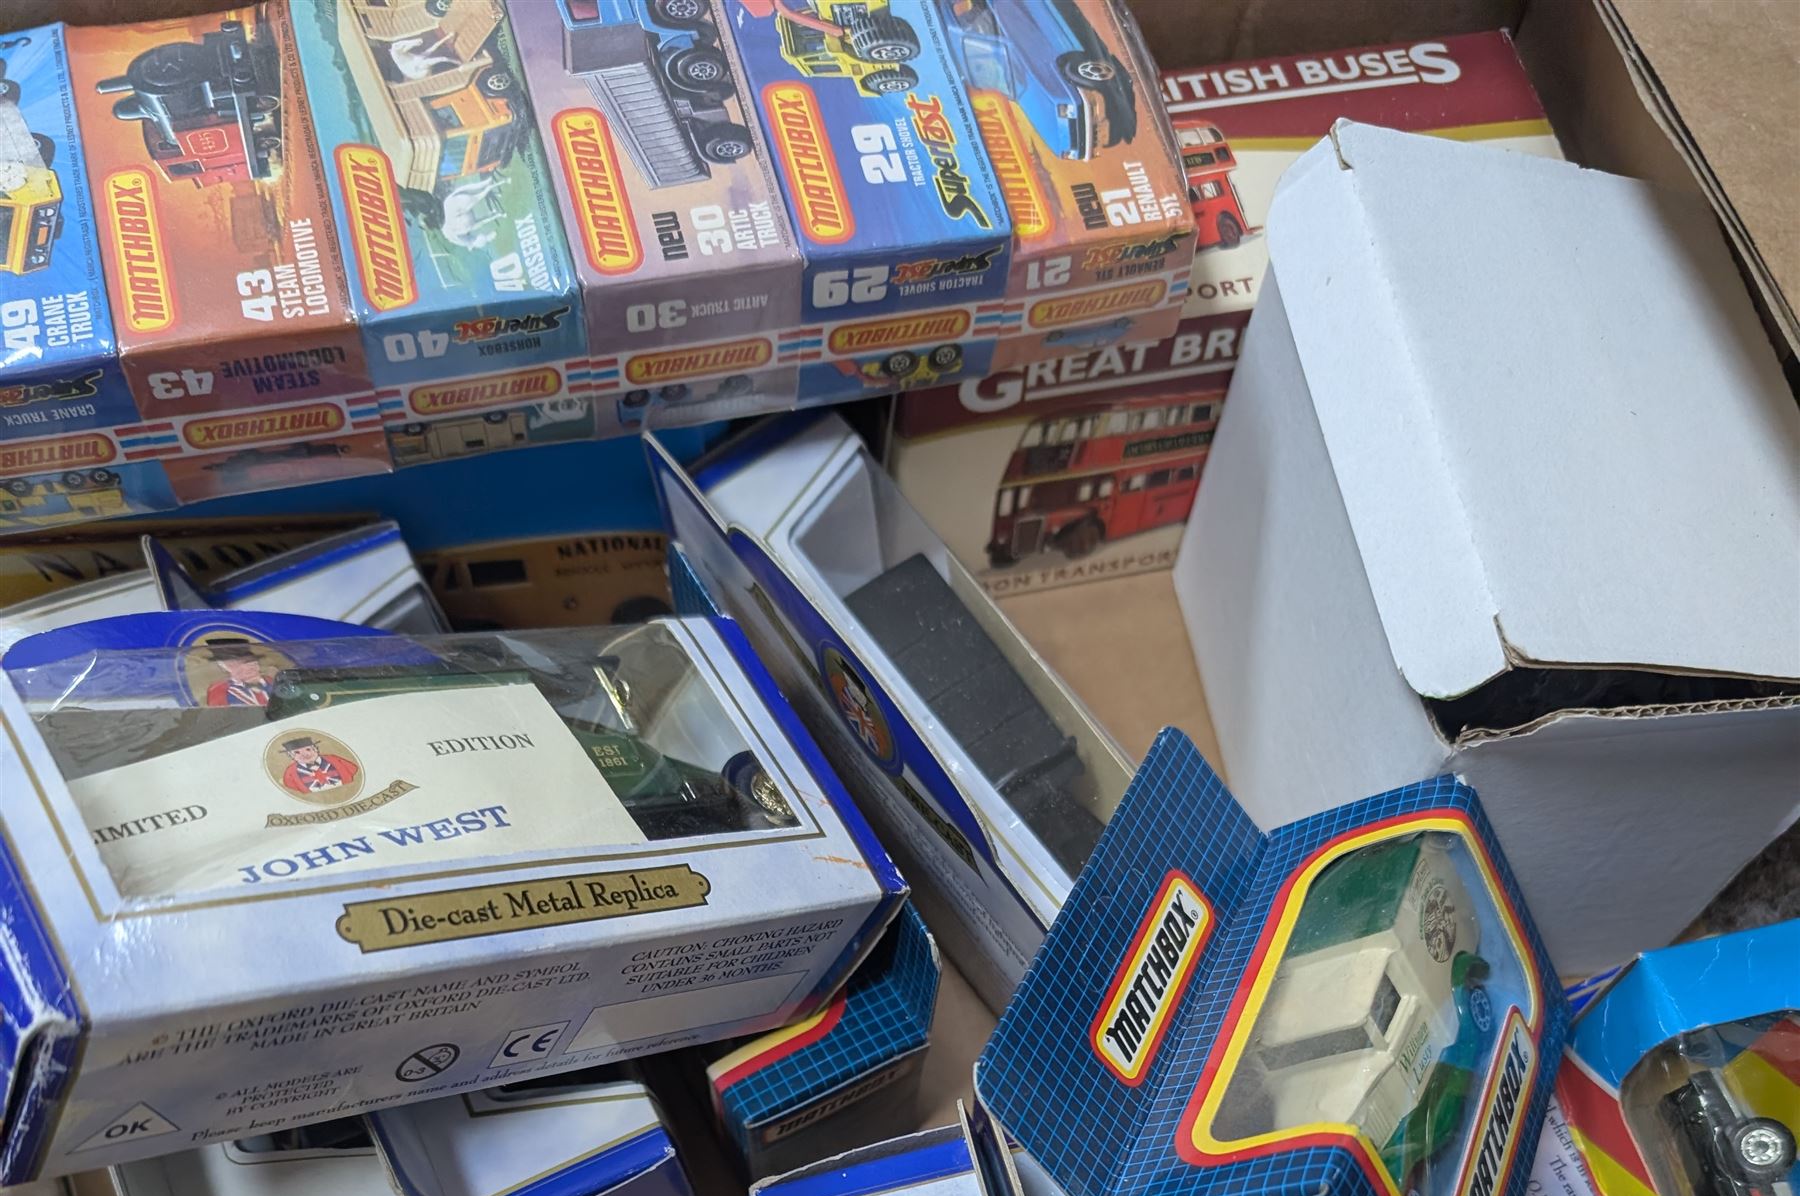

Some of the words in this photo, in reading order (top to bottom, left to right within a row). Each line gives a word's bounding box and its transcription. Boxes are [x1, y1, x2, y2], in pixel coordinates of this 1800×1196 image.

[1295, 43, 1461, 84] BUSES
[894, 118, 914, 149] SHOVEL
[851, 123, 908, 184] 29
[901, 148, 925, 187] TRACTOR
[1101, 187, 1141, 228] 21
[1123, 161, 1155, 222] RENAULT
[690, 205, 733, 255] 30
[728, 209, 757, 250] ARTIC
[747, 200, 779, 248] TRUCK
[290, 217, 331, 316] LOCOMOTIVE
[938, 274, 984, 290] TRACTOR
[1022, 255, 1074, 289] 21
[1116, 258, 1165, 278] RENAULT
[235, 268, 278, 322] 43
[273, 262, 304, 319] STEAM
[733, 293, 768, 310] ARTIC
[807, 261, 893, 310] 29
[898, 281, 936, 296] SHOVEL
[41, 293, 69, 347] CRANE
[62, 290, 93, 343] TRUCK
[624, 297, 689, 334] 30
[690, 299, 729, 317] TRUCK
[3, 299, 43, 361] 49
[382, 327, 450, 362] 40
[478, 337, 541, 356] HORSEBOX
[219, 344, 345, 377] LOCOMOTIVE
[639, 345, 760, 377] MATCHBOX
[958, 340, 1160, 413] GREAT
[147, 366, 215, 400] 43
[252, 368, 320, 394] STEAM
[422, 375, 549, 407] MATCHBOX
[3, 410, 48, 426] TRUCK
[50, 403, 95, 420] CRANE
[201, 410, 331, 442] MATCHBOX
[427, 733, 535, 756] EDITION
[592, 744, 621, 757] EST
[598, 756, 628, 768] 1861
[270, 808, 339, 826] OXFORD
[342, 781, 408, 817] DIE-CAST
[94, 804, 208, 845] IMITED
[238, 836, 375, 884] JOHN
[378, 805, 511, 847] WEST
[379, 899, 503, 937] Die-cast
[510, 886, 588, 918] Metal
[590, 880, 680, 916] Replica
[712, 928, 786, 948] CHOKING
[769, 918, 843, 938] HAZARD
[620, 953, 705, 975] CONTAINS
[704, 945, 756, 961] SMALL
[757, 936, 806, 952] PARTS
[805, 930, 839, 946] NOT
[625, 964, 707, 985] SUITABLE
[708, 958, 740, 970] FOR
[741, 945, 817, 965] CHILDREN
[640, 976, 697, 993] UNDER
[699, 974, 716, 983] 36
[718, 961, 786, 980] MONTHS
[1105, 888, 1198, 1065] MATCHBOX
[221, 1010, 357, 1045] TRADEMARKS
[362, 1003, 390, 1018] OF
[394, 990, 472, 1012] OXFORD
[474, 976, 553, 998] DIE-CAST
[224, 1006, 312, 1032] OXFORD
[413, 979, 465, 998] NAME
[469, 973, 509, 988] AND
[510, 960, 581, 982] SYMBOL
[248, 1031, 309, 1051] MADE
[311, 1026, 335, 1039] IN
[338, 1013, 406, 1033] GREAT
[406, 1000, 480, 1021] BRITAIN
[240, 1078, 334, 1105] PROTECTED
[249, 1085, 339, 1112] COPYRIGHT
[266, 1070, 330, 1091] MODELS
[105, 1117, 150, 1138] OK
[1546, 1112, 1577, 1150] which
[1547, 1153, 1572, 1182] The
